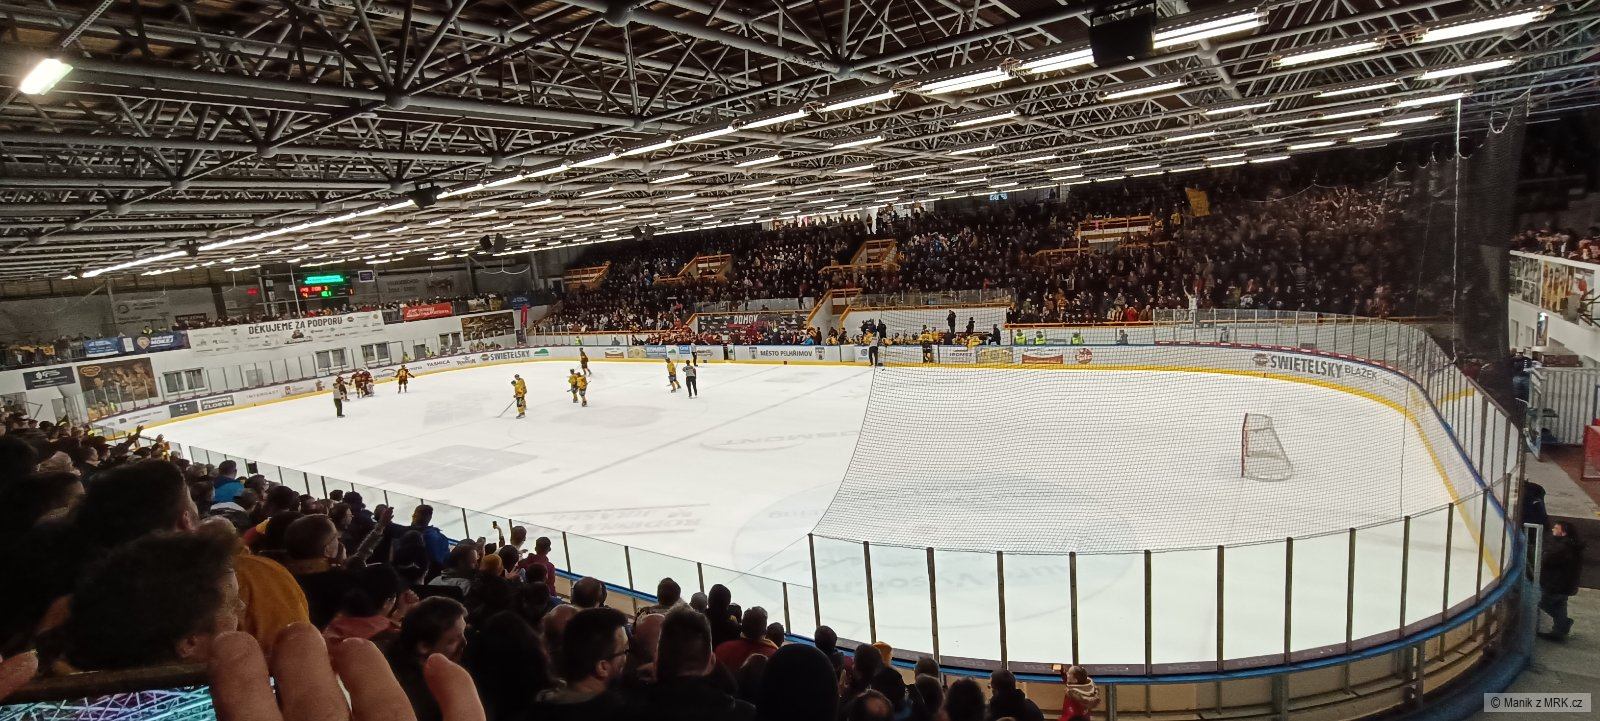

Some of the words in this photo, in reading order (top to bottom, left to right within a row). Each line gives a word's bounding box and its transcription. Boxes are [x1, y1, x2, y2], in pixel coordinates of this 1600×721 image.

[248, 321, 293, 334] DĚKUJEME
[295, 320, 305, 329] ZA
[307, 317, 343, 328] PODPORU
[733, 314, 759, 325] DOMOV
[490, 349, 530, 361] SWIETELSKY
[760, 349, 779, 357] MĚSTO
[780, 349, 813, 357] PELHŘIMOV
[1269, 355, 1343, 379] SWIETELSKY
